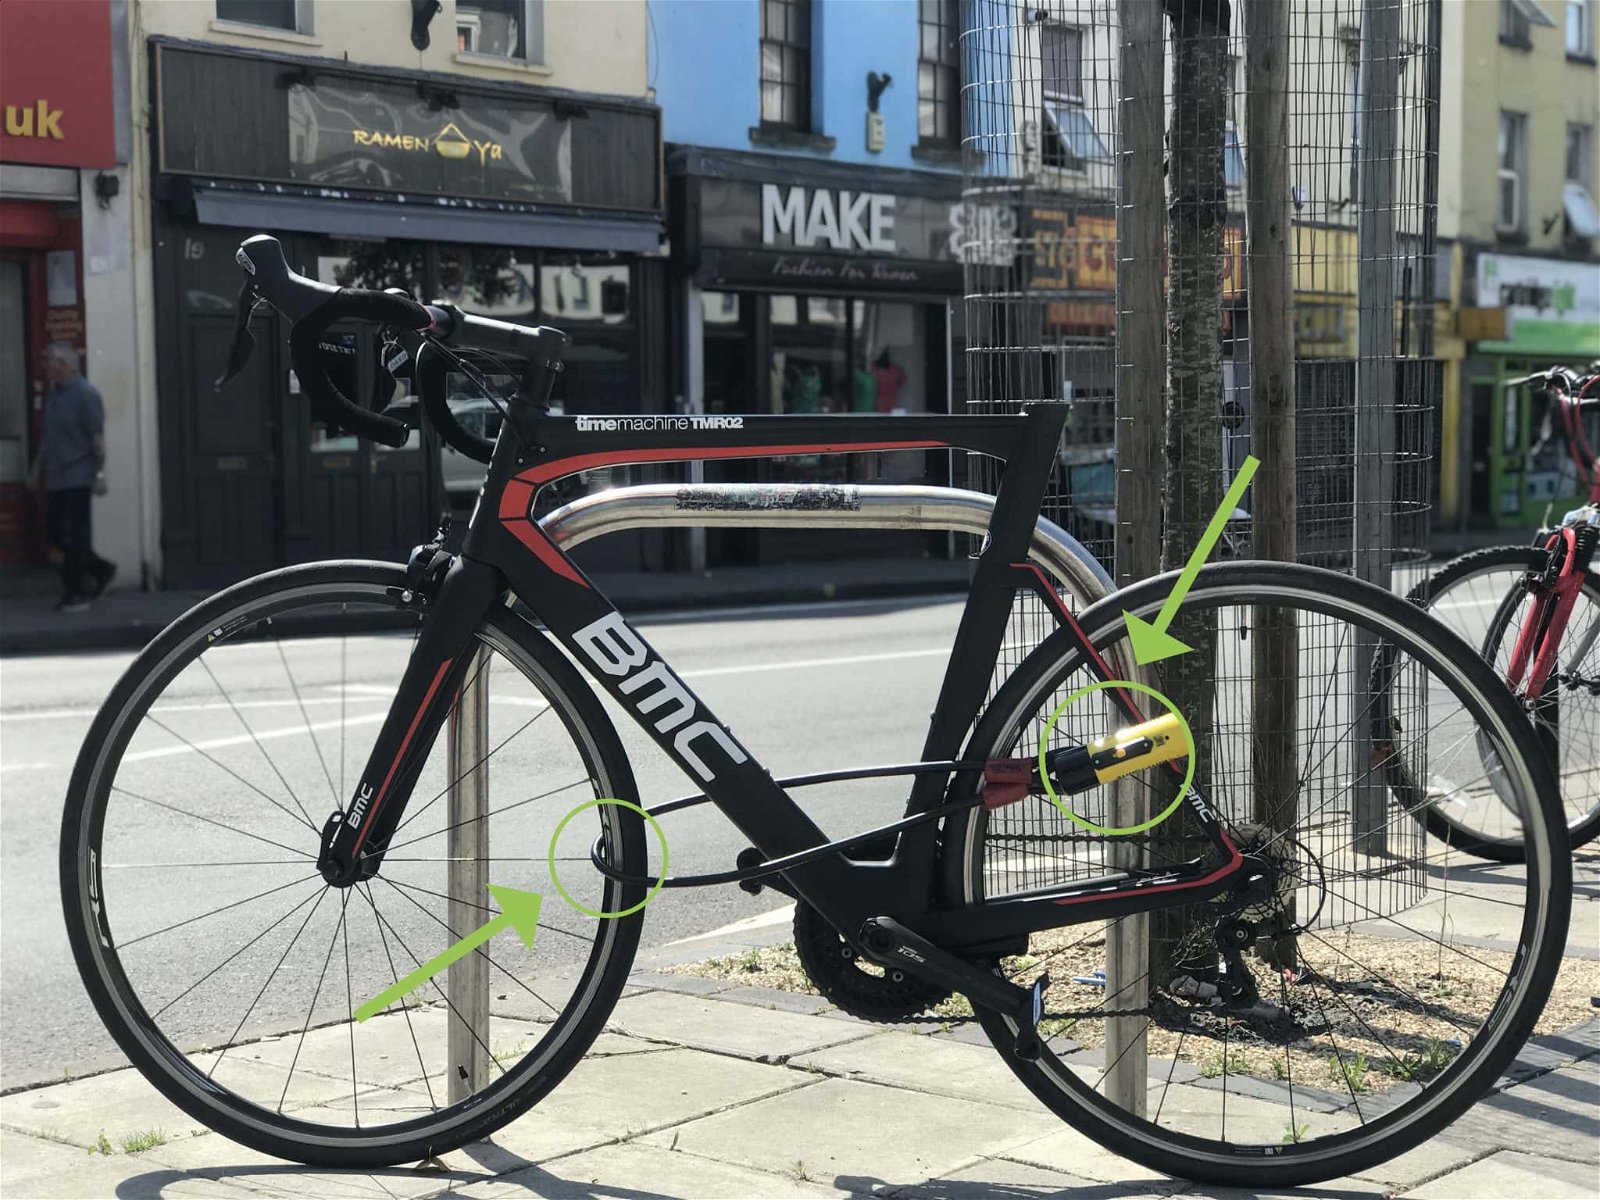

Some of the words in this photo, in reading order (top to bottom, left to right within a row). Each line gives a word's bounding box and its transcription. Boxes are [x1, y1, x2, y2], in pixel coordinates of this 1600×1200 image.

[6, 99, 65, 140] uk
[352, 130, 429, 152] RAMEN
[474, 140, 501, 166] Ya
[762, 184, 896, 250] MAKE
[839, 260, 867, 279] For
[690, 417, 744, 430] TMR02
[571, 611, 748, 783] BMC
[347, 782, 374, 830] BMC
